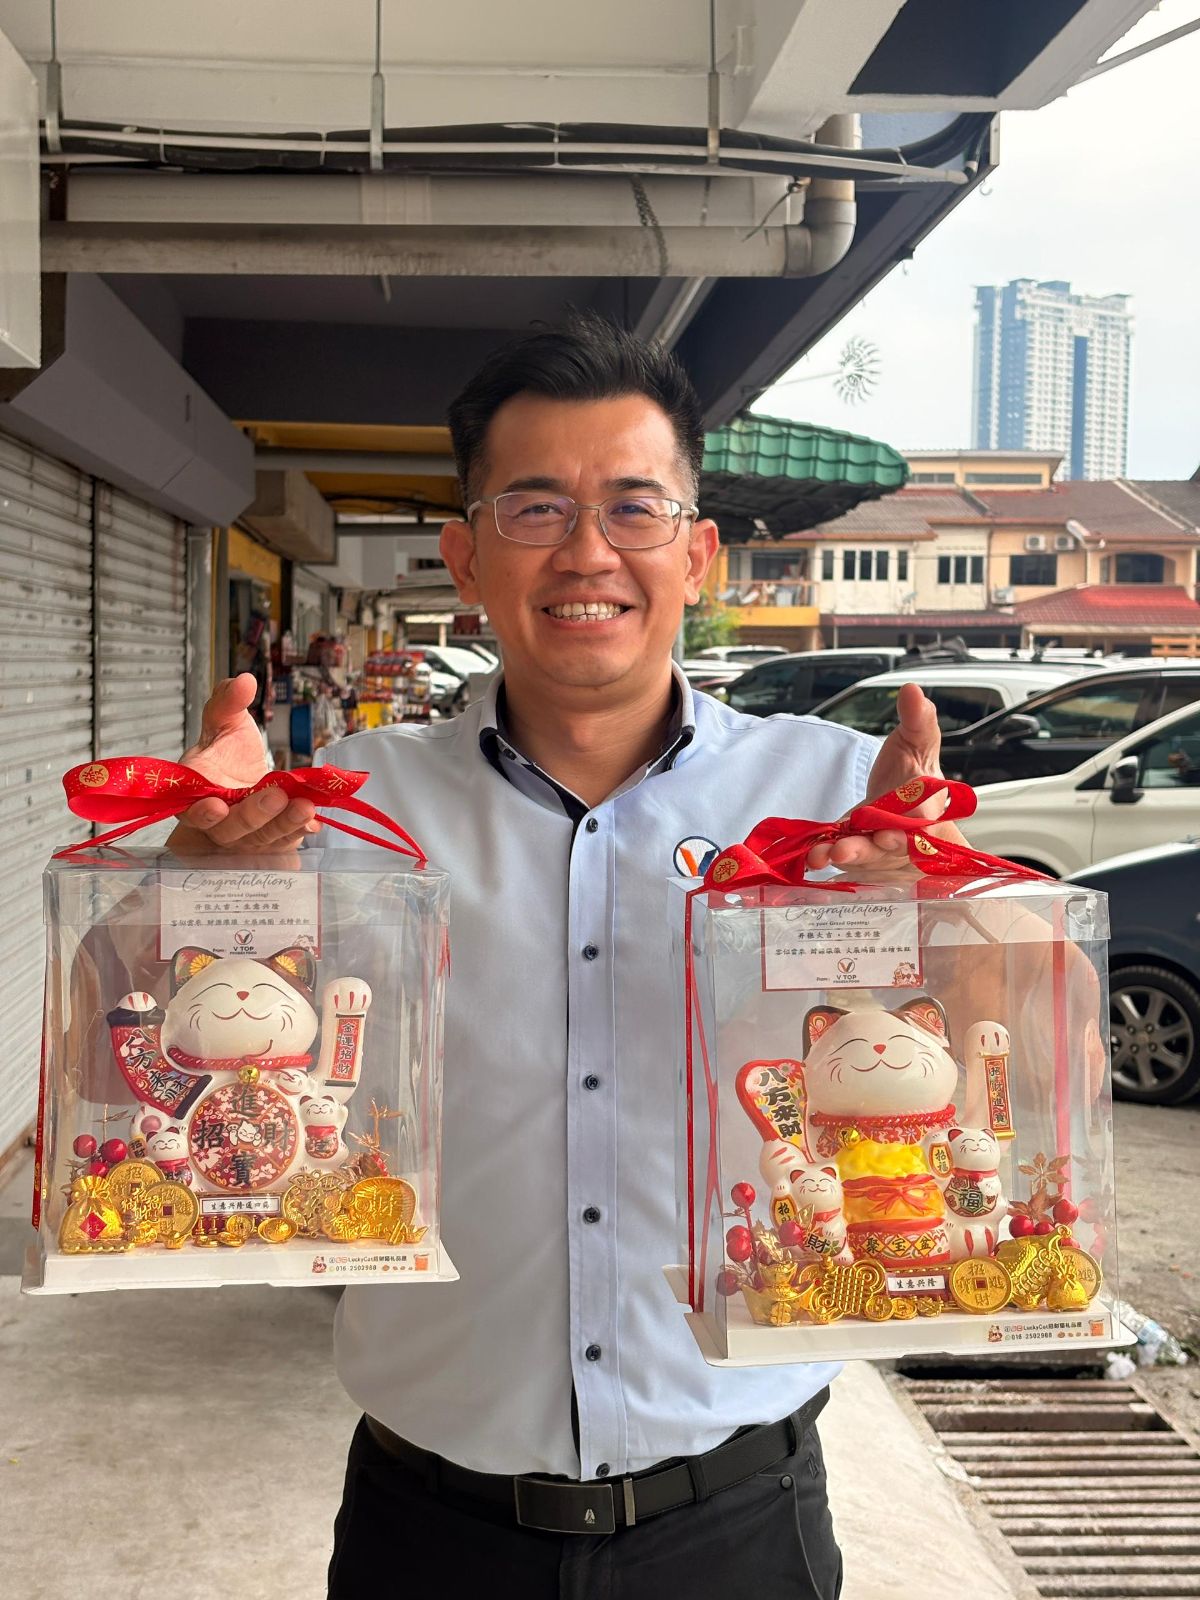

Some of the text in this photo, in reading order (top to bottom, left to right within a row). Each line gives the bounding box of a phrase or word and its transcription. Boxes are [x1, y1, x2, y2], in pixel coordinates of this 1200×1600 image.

[182, 872, 297, 892] Congratulations
[785, 899, 898, 921] Congratulations
[230, 1085, 261, 1117] 進
[192, 1120, 225, 1149] 招
[263, 1118, 290, 1152] 財
[935, 1149, 949, 1172] 招福
[958, 1188, 980, 1208] 福
[866, 1236, 931, 1253] 聚宝盆
